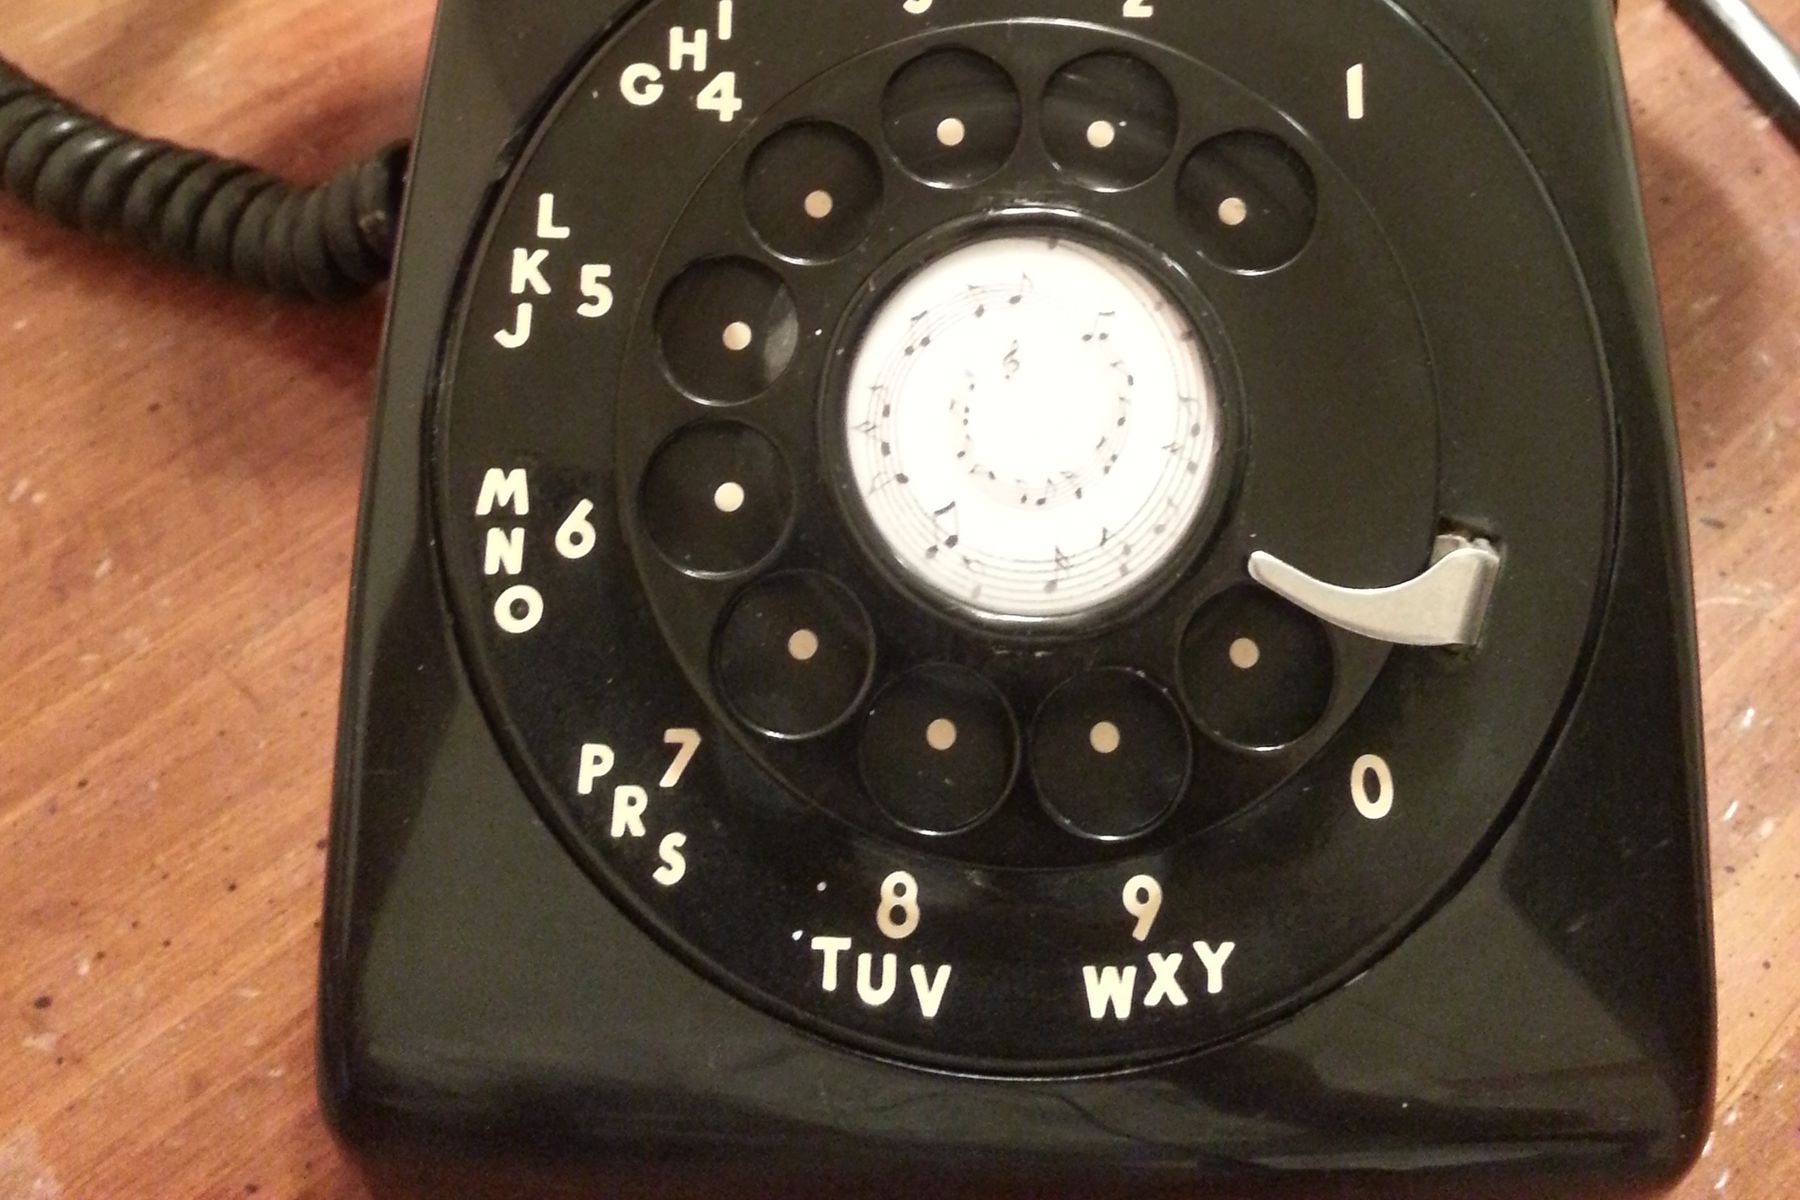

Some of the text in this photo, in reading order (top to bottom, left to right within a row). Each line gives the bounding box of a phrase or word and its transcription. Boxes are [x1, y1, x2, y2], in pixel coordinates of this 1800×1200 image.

[694, 70, 744, 124] 4
[575, 262, 615, 319] 5
[553, 497, 598, 561] 6
[658, 727, 702, 789] 7
[875, 869, 921, 940] 8
[1121, 873, 1163, 943] 9
[809, 935, 953, 1020] TUV
[1081, 939, 1237, 1021] WXY
